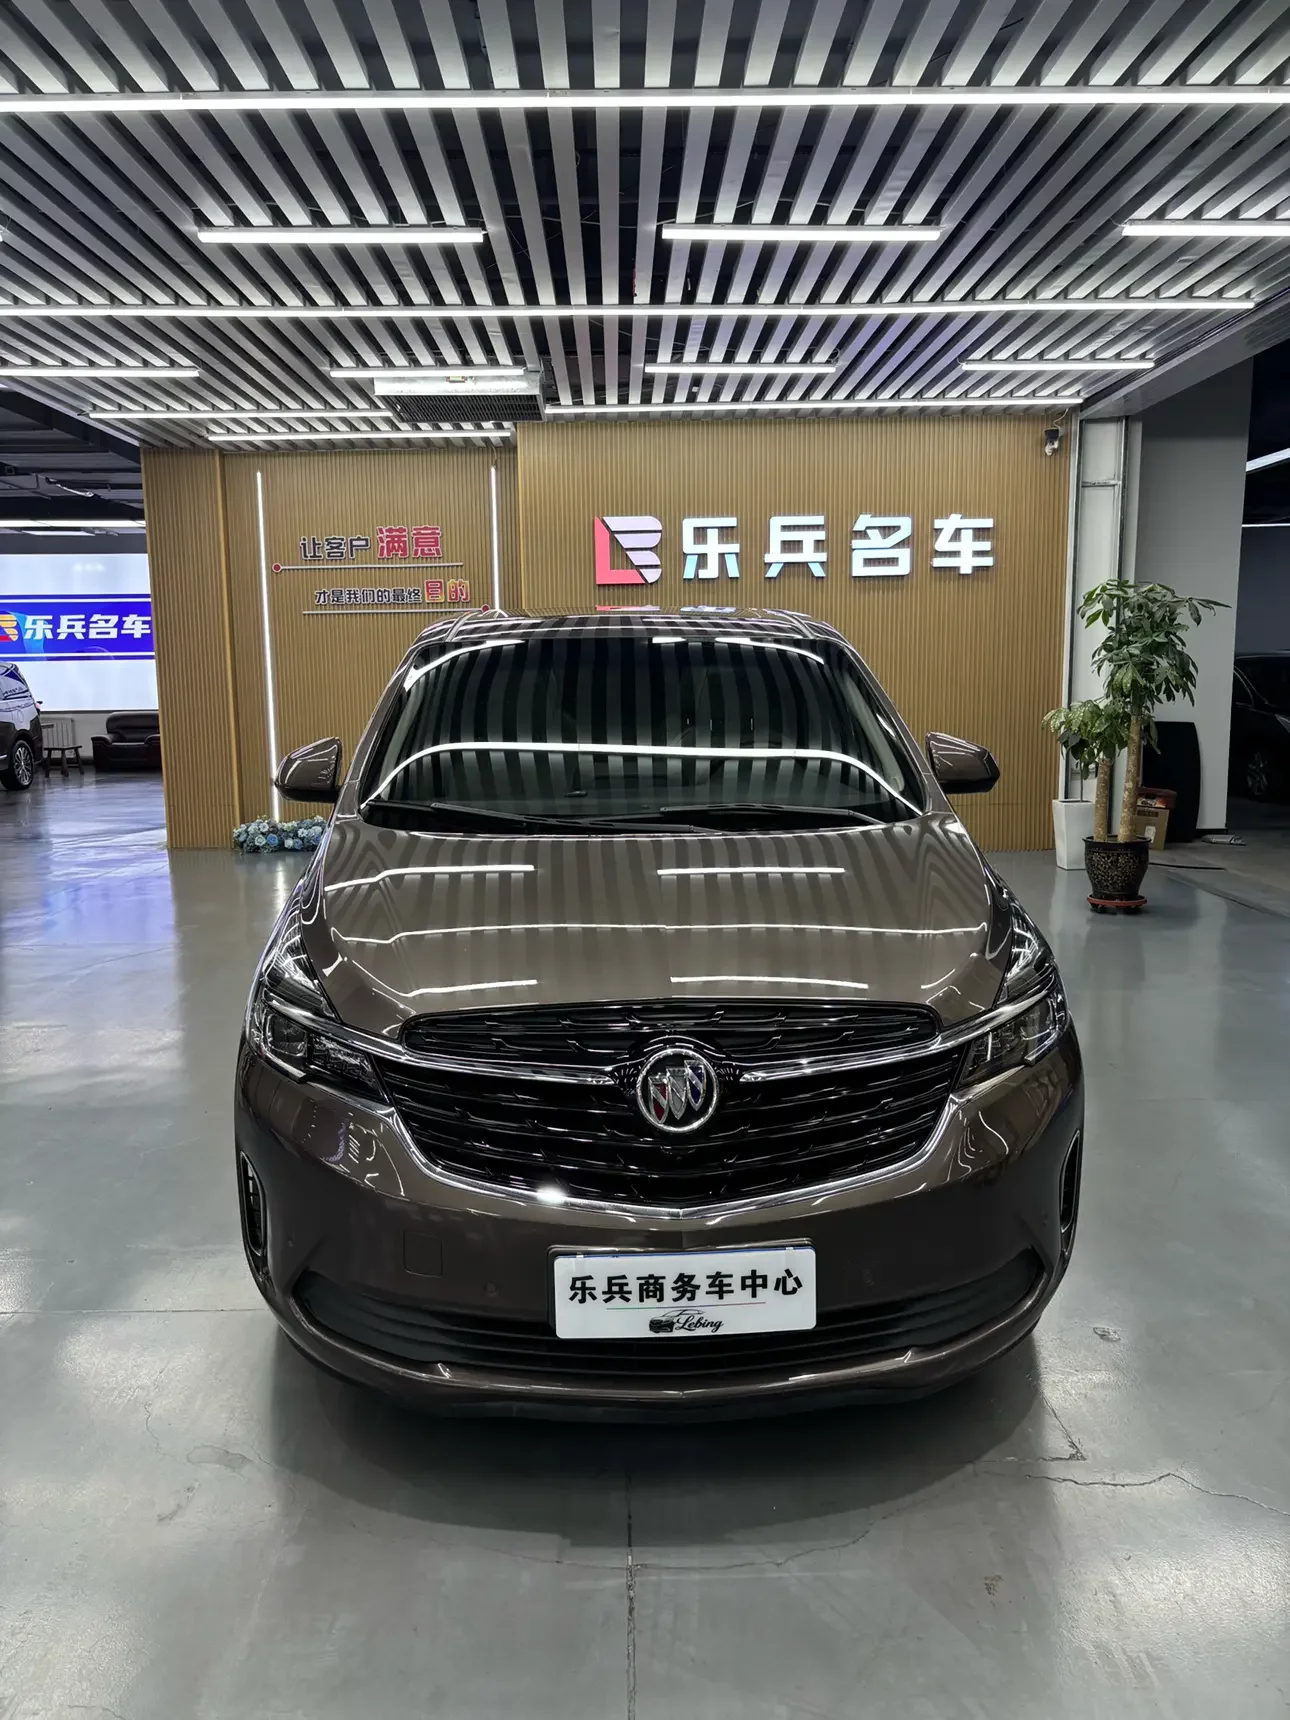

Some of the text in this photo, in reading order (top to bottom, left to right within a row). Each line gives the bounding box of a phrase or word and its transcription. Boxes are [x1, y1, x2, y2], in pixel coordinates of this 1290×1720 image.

[300, 525, 443, 560] 让客户满意
[682, 513, 995, 580] 乐兵名车
[315, 579, 470, 605] 才是我们的最终目的
[24, 613, 152, 641] 乐兵名车
[568, 1268, 804, 1305] 乐兵商务车中心
[675, 1314, 724, 1334] Lebing
